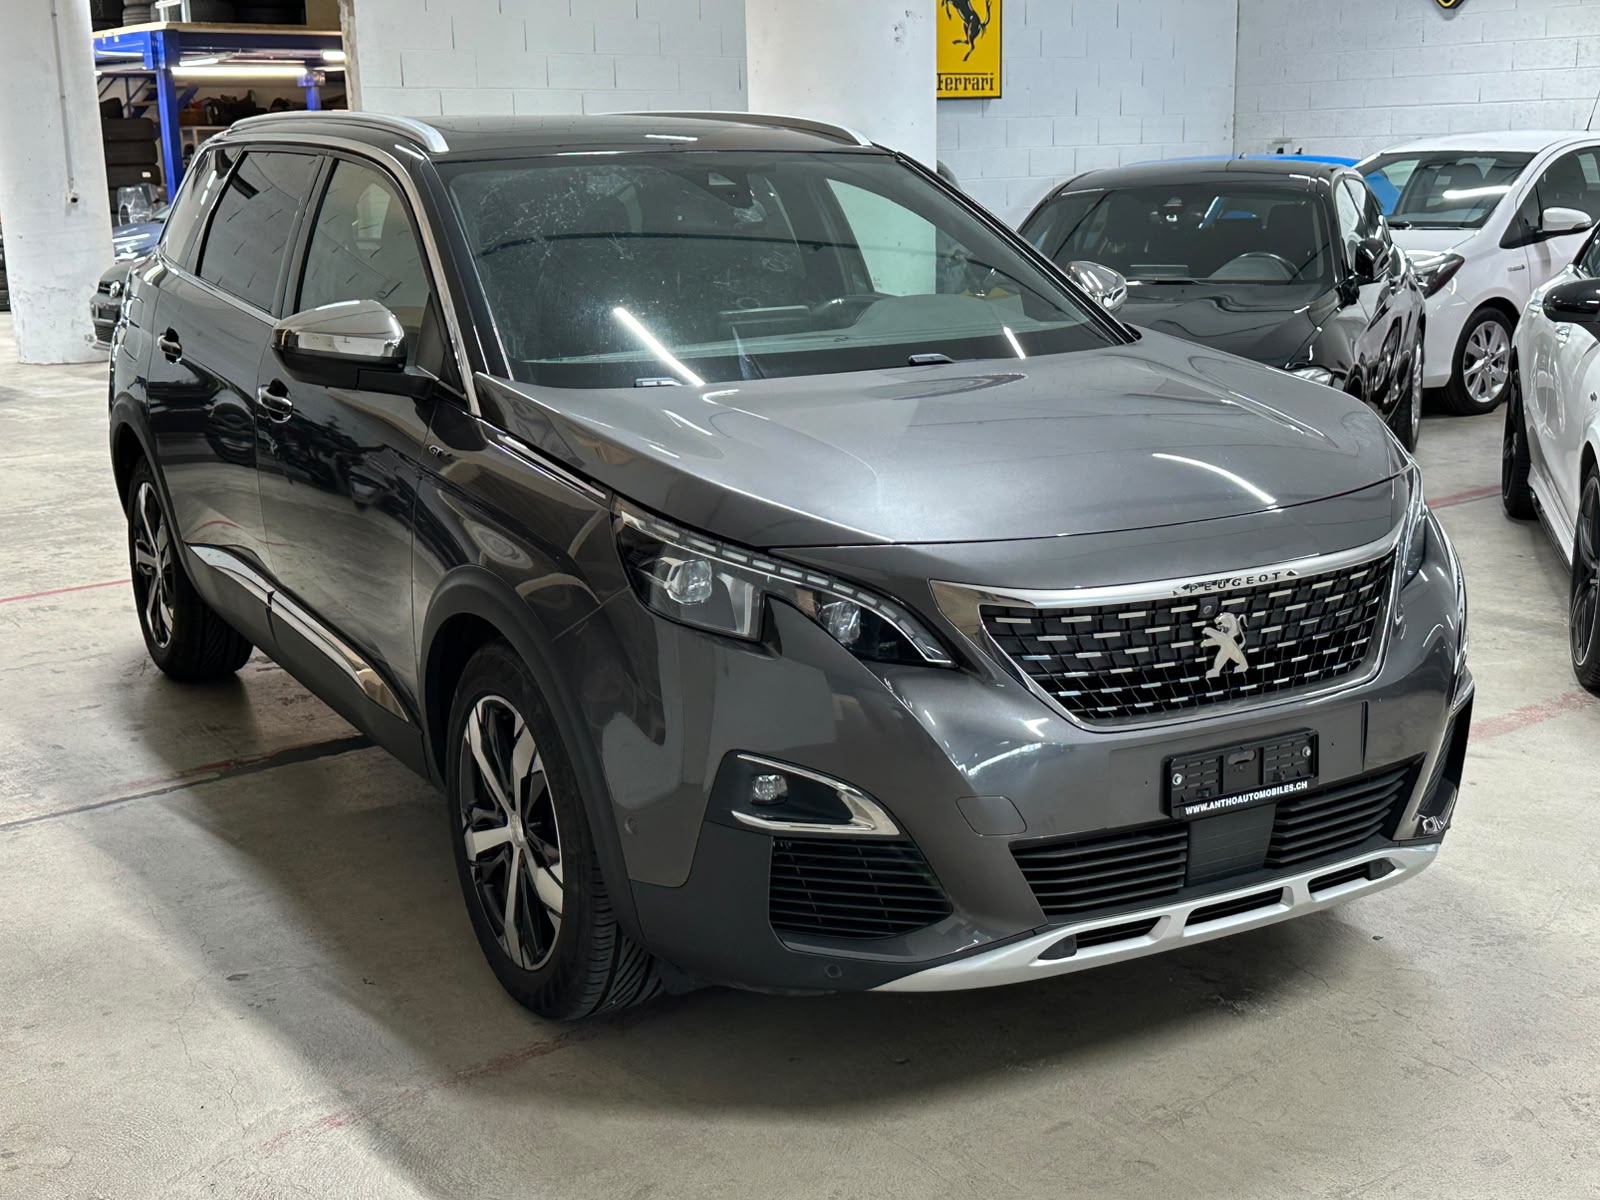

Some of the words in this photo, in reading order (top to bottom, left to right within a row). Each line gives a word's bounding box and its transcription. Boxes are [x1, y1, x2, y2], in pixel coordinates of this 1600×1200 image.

[936, 72, 994, 91] Ferrari
[1189, 572, 1281, 593] PEUGEOT
[1185, 781, 1307, 814] WWW.ANTHOAUTOMOBILES.CH
